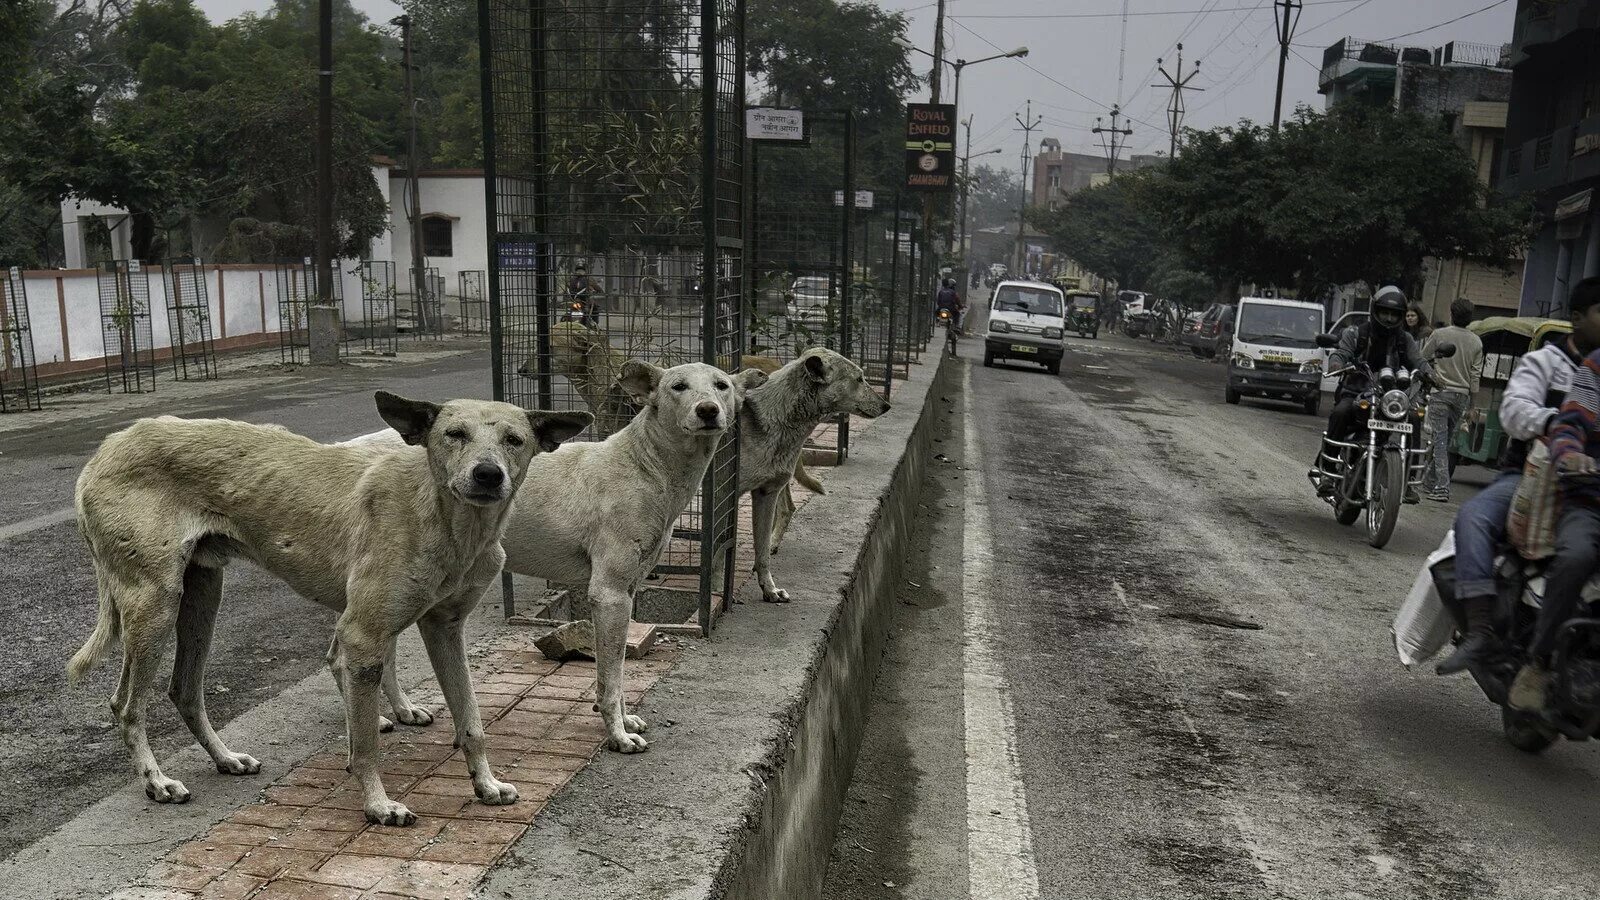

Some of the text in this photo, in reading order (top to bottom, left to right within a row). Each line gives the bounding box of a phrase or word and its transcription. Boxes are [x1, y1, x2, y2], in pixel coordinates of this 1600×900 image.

[913, 109, 946, 121] ROYAL
[909, 122, 950, 135] ENFIELD
[908, 174, 949, 186] SHAMBHAVI
